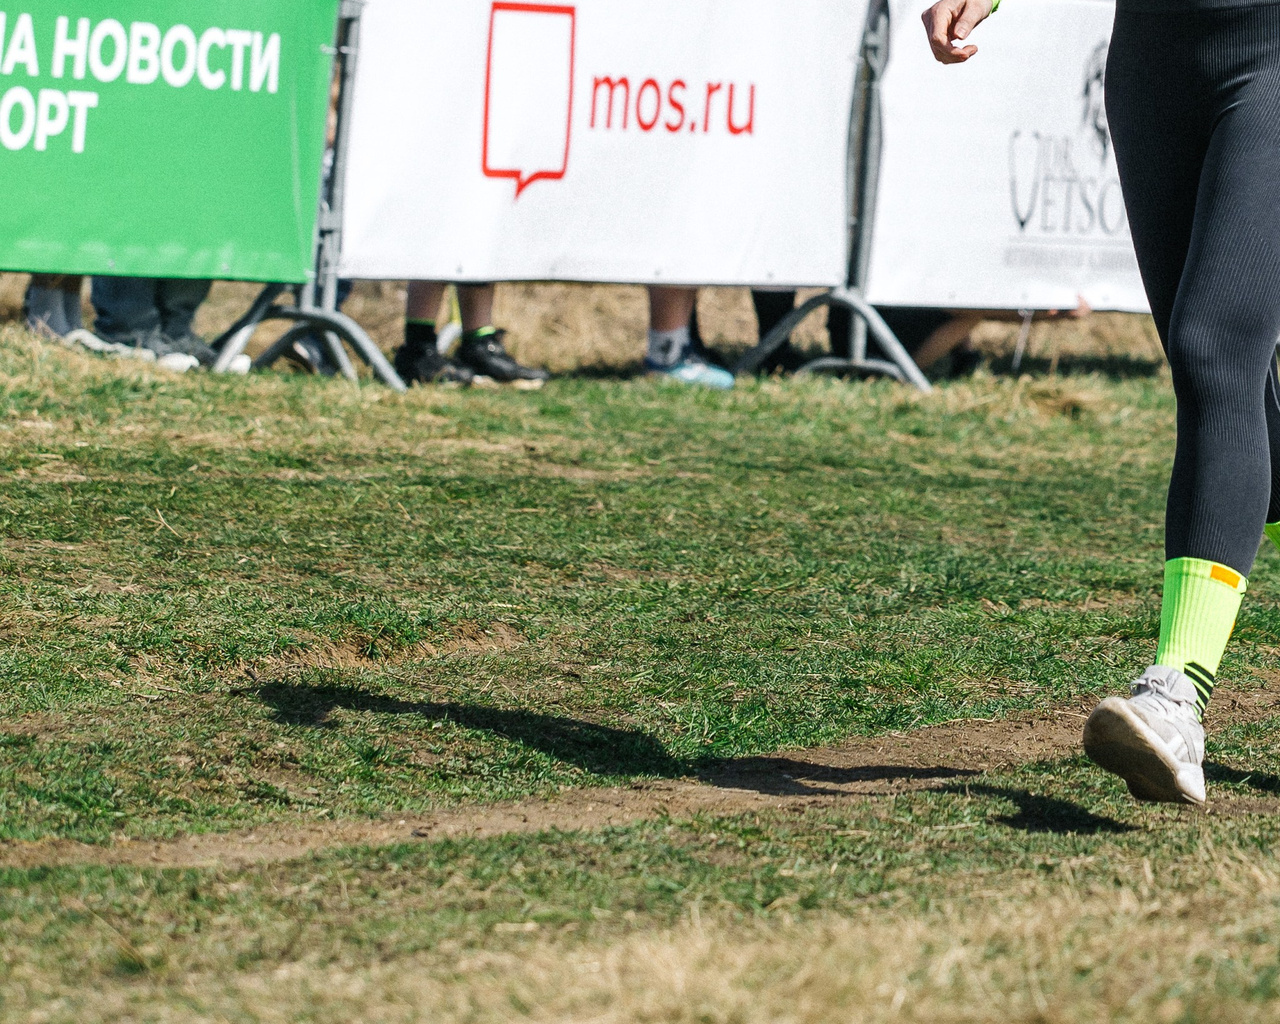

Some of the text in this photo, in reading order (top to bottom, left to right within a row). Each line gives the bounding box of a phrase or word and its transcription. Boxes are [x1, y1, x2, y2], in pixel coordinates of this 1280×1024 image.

[51, 16, 281, 94] НОВОСТИ
[0, 85, 99, 154] ОРТ
[589, 75, 755, 136] mos.ru
[1008, 129, 1131, 236] VETSO
